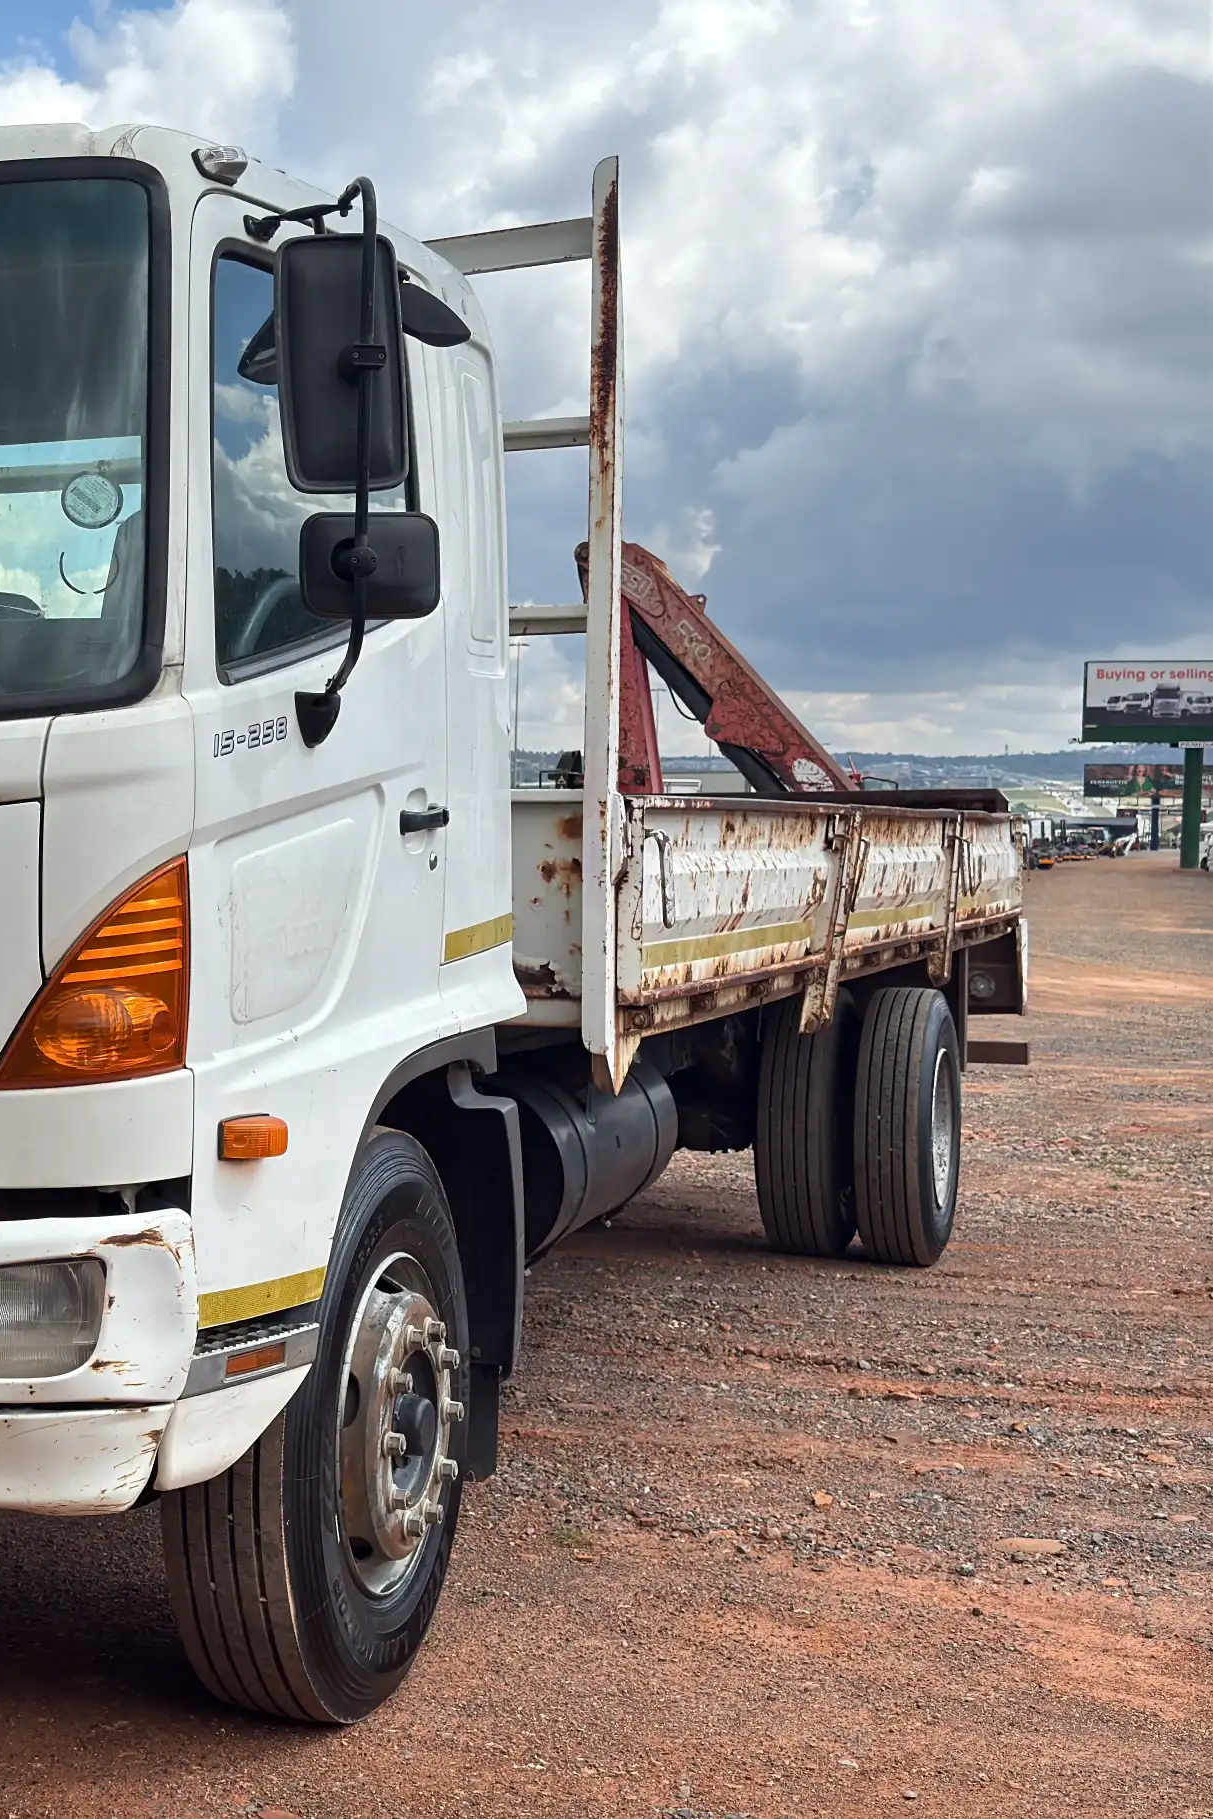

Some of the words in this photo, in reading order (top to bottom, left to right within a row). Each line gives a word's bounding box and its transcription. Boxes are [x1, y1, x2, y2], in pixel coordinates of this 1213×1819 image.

[1096, 669, 1146, 682] Buying
[1150, 671, 1166, 679] or
[1169, 669, 1213, 682] selling
[213, 716, 288, 758] 15-258
